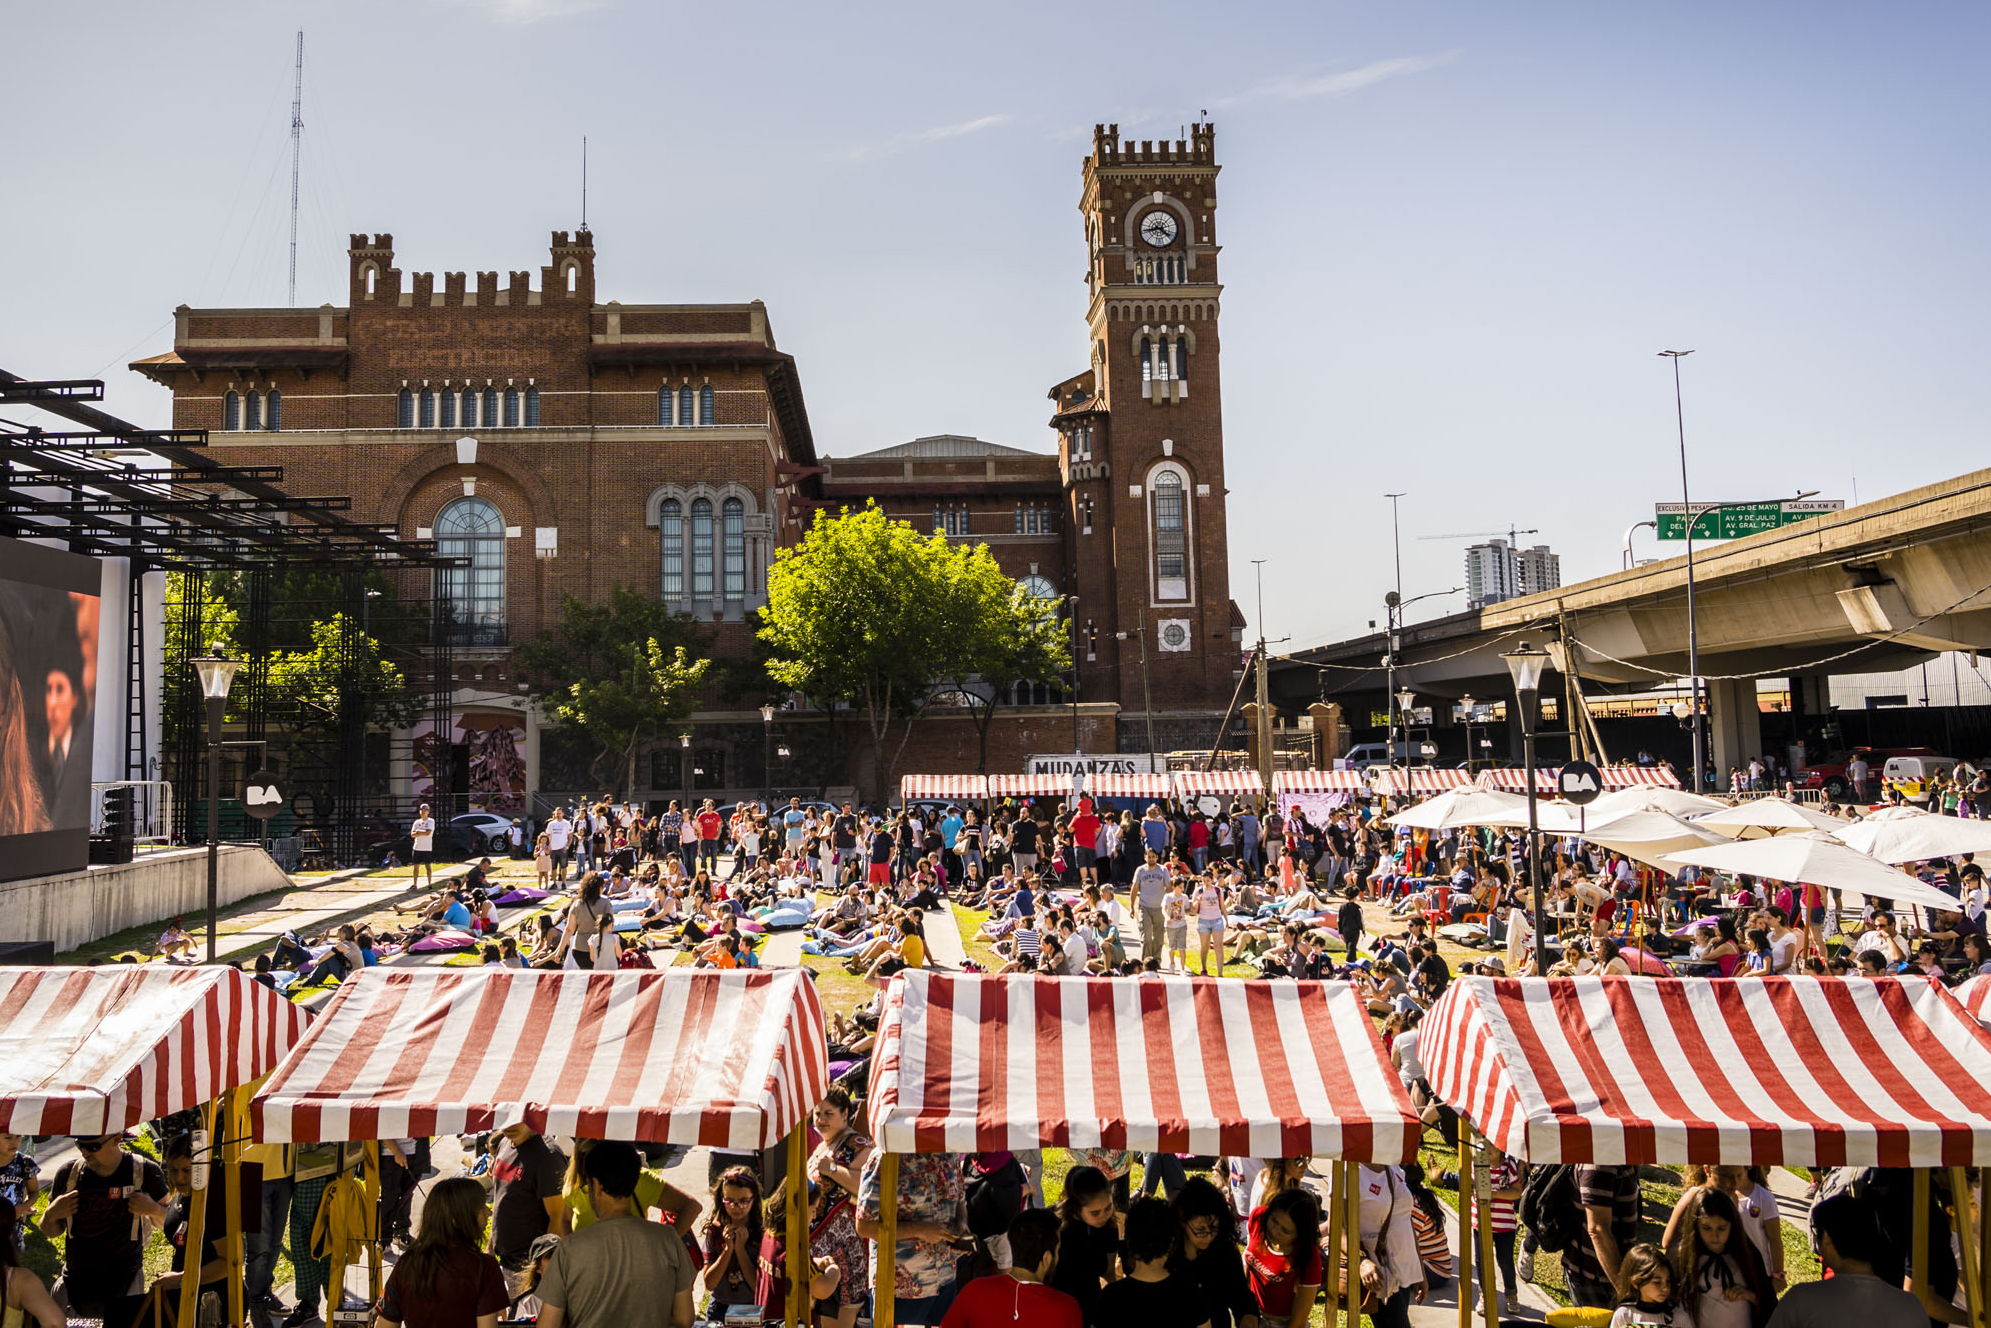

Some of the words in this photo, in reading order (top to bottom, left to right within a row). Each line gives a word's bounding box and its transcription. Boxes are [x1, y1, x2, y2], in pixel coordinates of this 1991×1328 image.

[1420, 745, 1436, 754] BA
[1480, 740, 1492, 748] BA
[778, 748, 790, 756] BA
[1036, 761, 1135, 777] MUDANZAS
[1563, 772, 1597, 792] BA
[247, 784, 282, 805] BA
